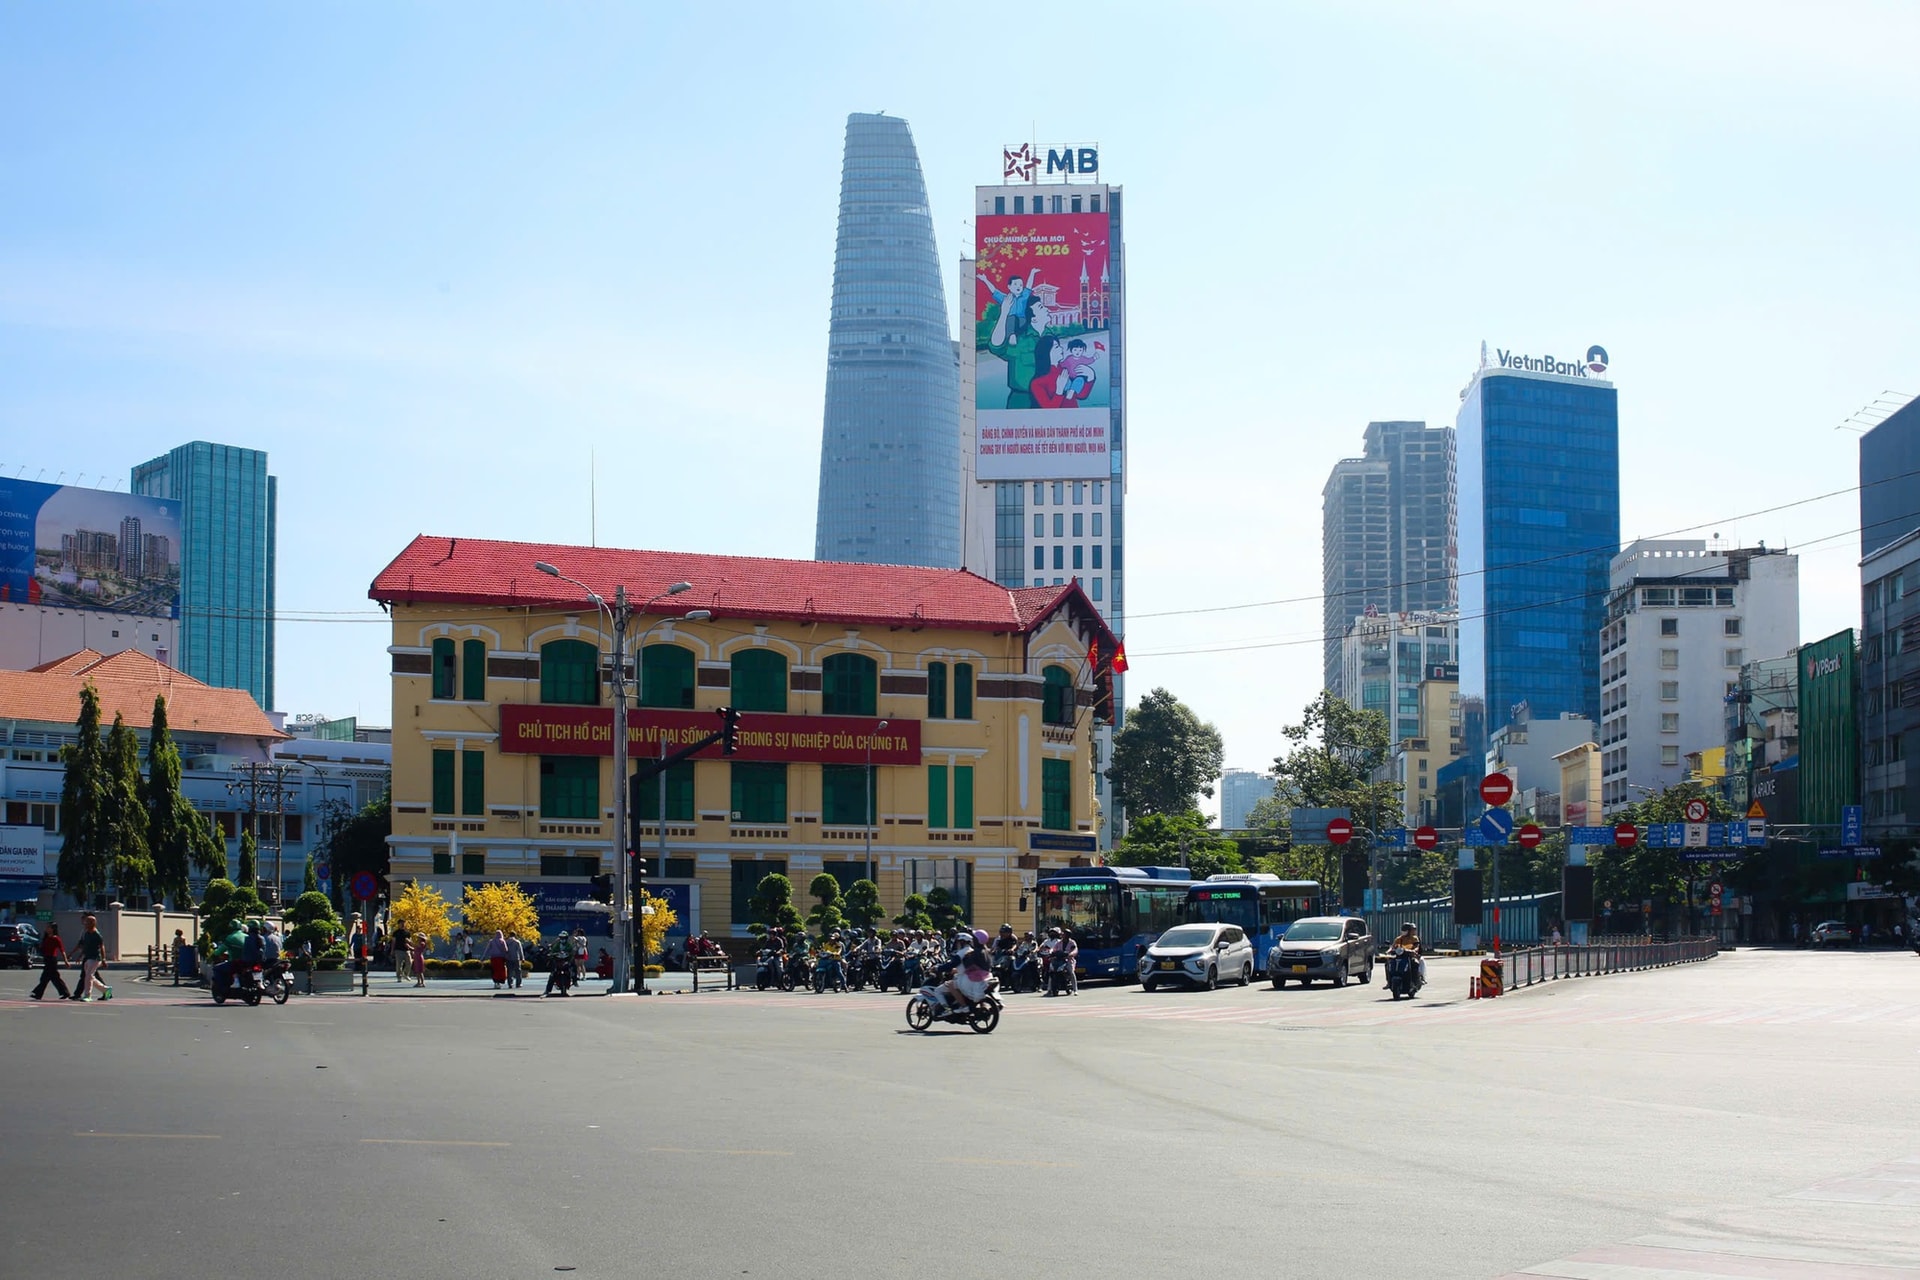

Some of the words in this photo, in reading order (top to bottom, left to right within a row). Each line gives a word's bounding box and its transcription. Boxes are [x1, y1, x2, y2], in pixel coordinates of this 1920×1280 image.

[1047, 149, 1098, 174] MB
[1035, 244, 1070, 256] 2026
[1496, 348, 1587, 377] VietinBank
[1815, 654, 1841, 677] VPBank
[518, 719, 542, 738] CHỦ
[545, 723, 570, 742] TỊCH
[573, 721, 590, 741] HỒ
[592, 723, 611, 741] CHÍ
[646, 726, 659, 742] VĨ
[660, 728, 679, 746] ĐẠI
[736, 731, 772, 746] TRONG
[775, 731, 789, 750] SỰ
[791, 731, 830, 751] NGHIỆP
[833, 730, 854, 749] CỦA
[856, 732, 892, 751] CHÚNG
[894, 736, 908, 751] TA
